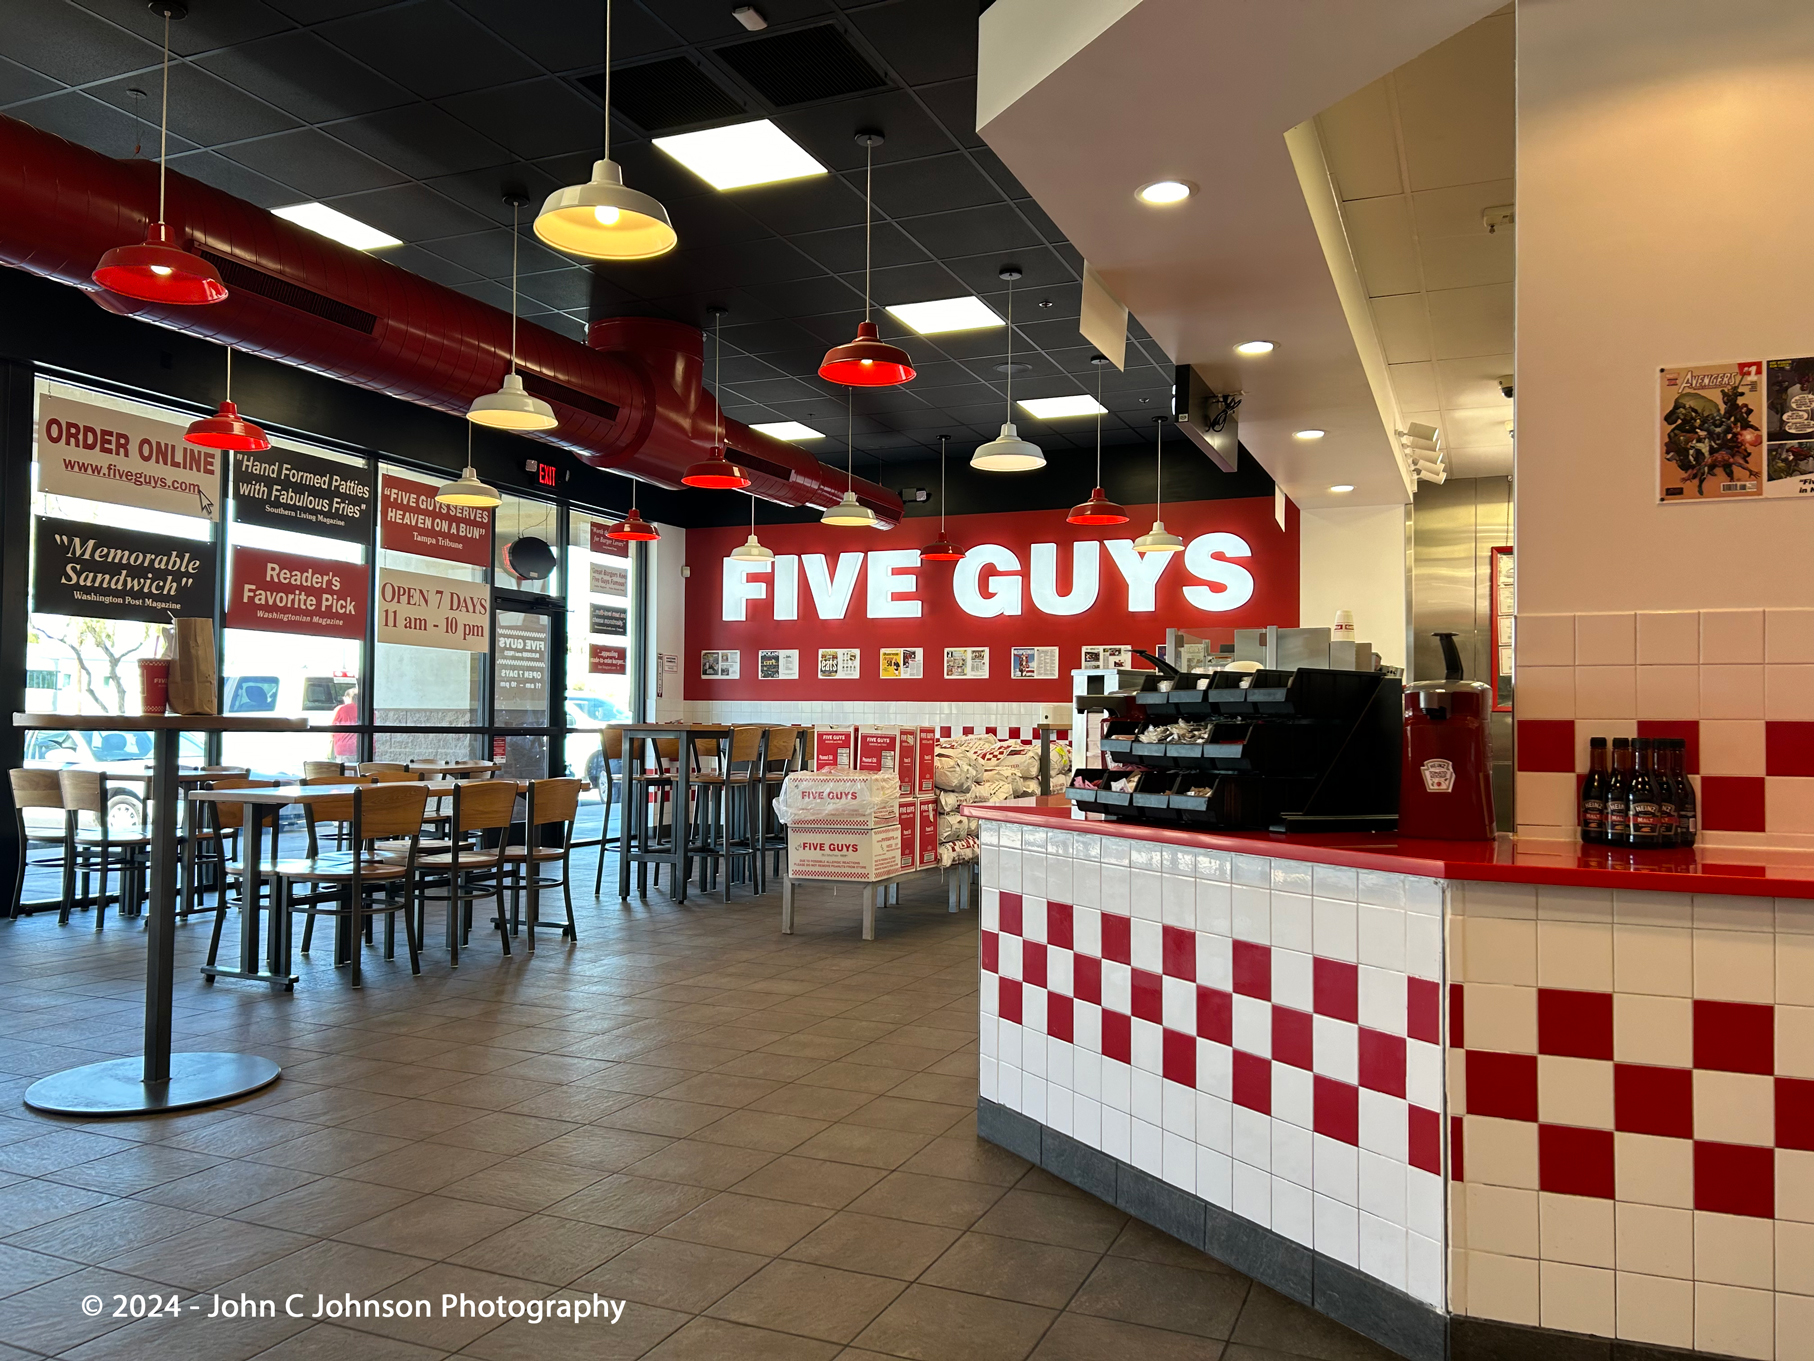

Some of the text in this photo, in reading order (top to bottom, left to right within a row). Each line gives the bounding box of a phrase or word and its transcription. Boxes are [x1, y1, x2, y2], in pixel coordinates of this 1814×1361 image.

[1678, 370, 1738, 393] AVENGERS
[46, 418, 215, 475] ORDER ONLINE
[63, 458, 201, 493] www.fiveguys.com
[236, 453, 370, 498] "Hand Formed Patties
[539, 463, 556, 487] EXIT
[239, 481, 367, 518] with Fabulous Fries"
[265, 504, 346, 526] Southern Living Magazine
[384, 487, 489, 523] “FIVE GUYS SERVES
[387, 507, 486, 539] HEAVEN ON A BUN”
[54, 534, 200, 573] "Memorable
[413, 532, 463, 550] Tampa Tribune
[60, 563, 193, 596] Sandwich"
[266, 562, 341, 590] Reader's
[722, 532, 1255, 622] FIVE GUYS
[73, 591, 181, 610] Washington Post Magazine
[243, 583, 356, 615] Favorite Pick
[381, 581, 488, 615] OPEN 7 DAYS
[257, 610, 344, 626] Washingtonian Magazine
[383, 608, 398, 628] 11
[404, 616, 428, 631] am
[444, 616, 458, 635] 10
[463, 622, 485, 640] pm
[821, 659, 837, 671] eats
[801, 791, 858, 800] FIVE GUYS
[1635, 805, 1656, 813] HEINZ
[802, 842, 859, 852] FIVE GUYS
